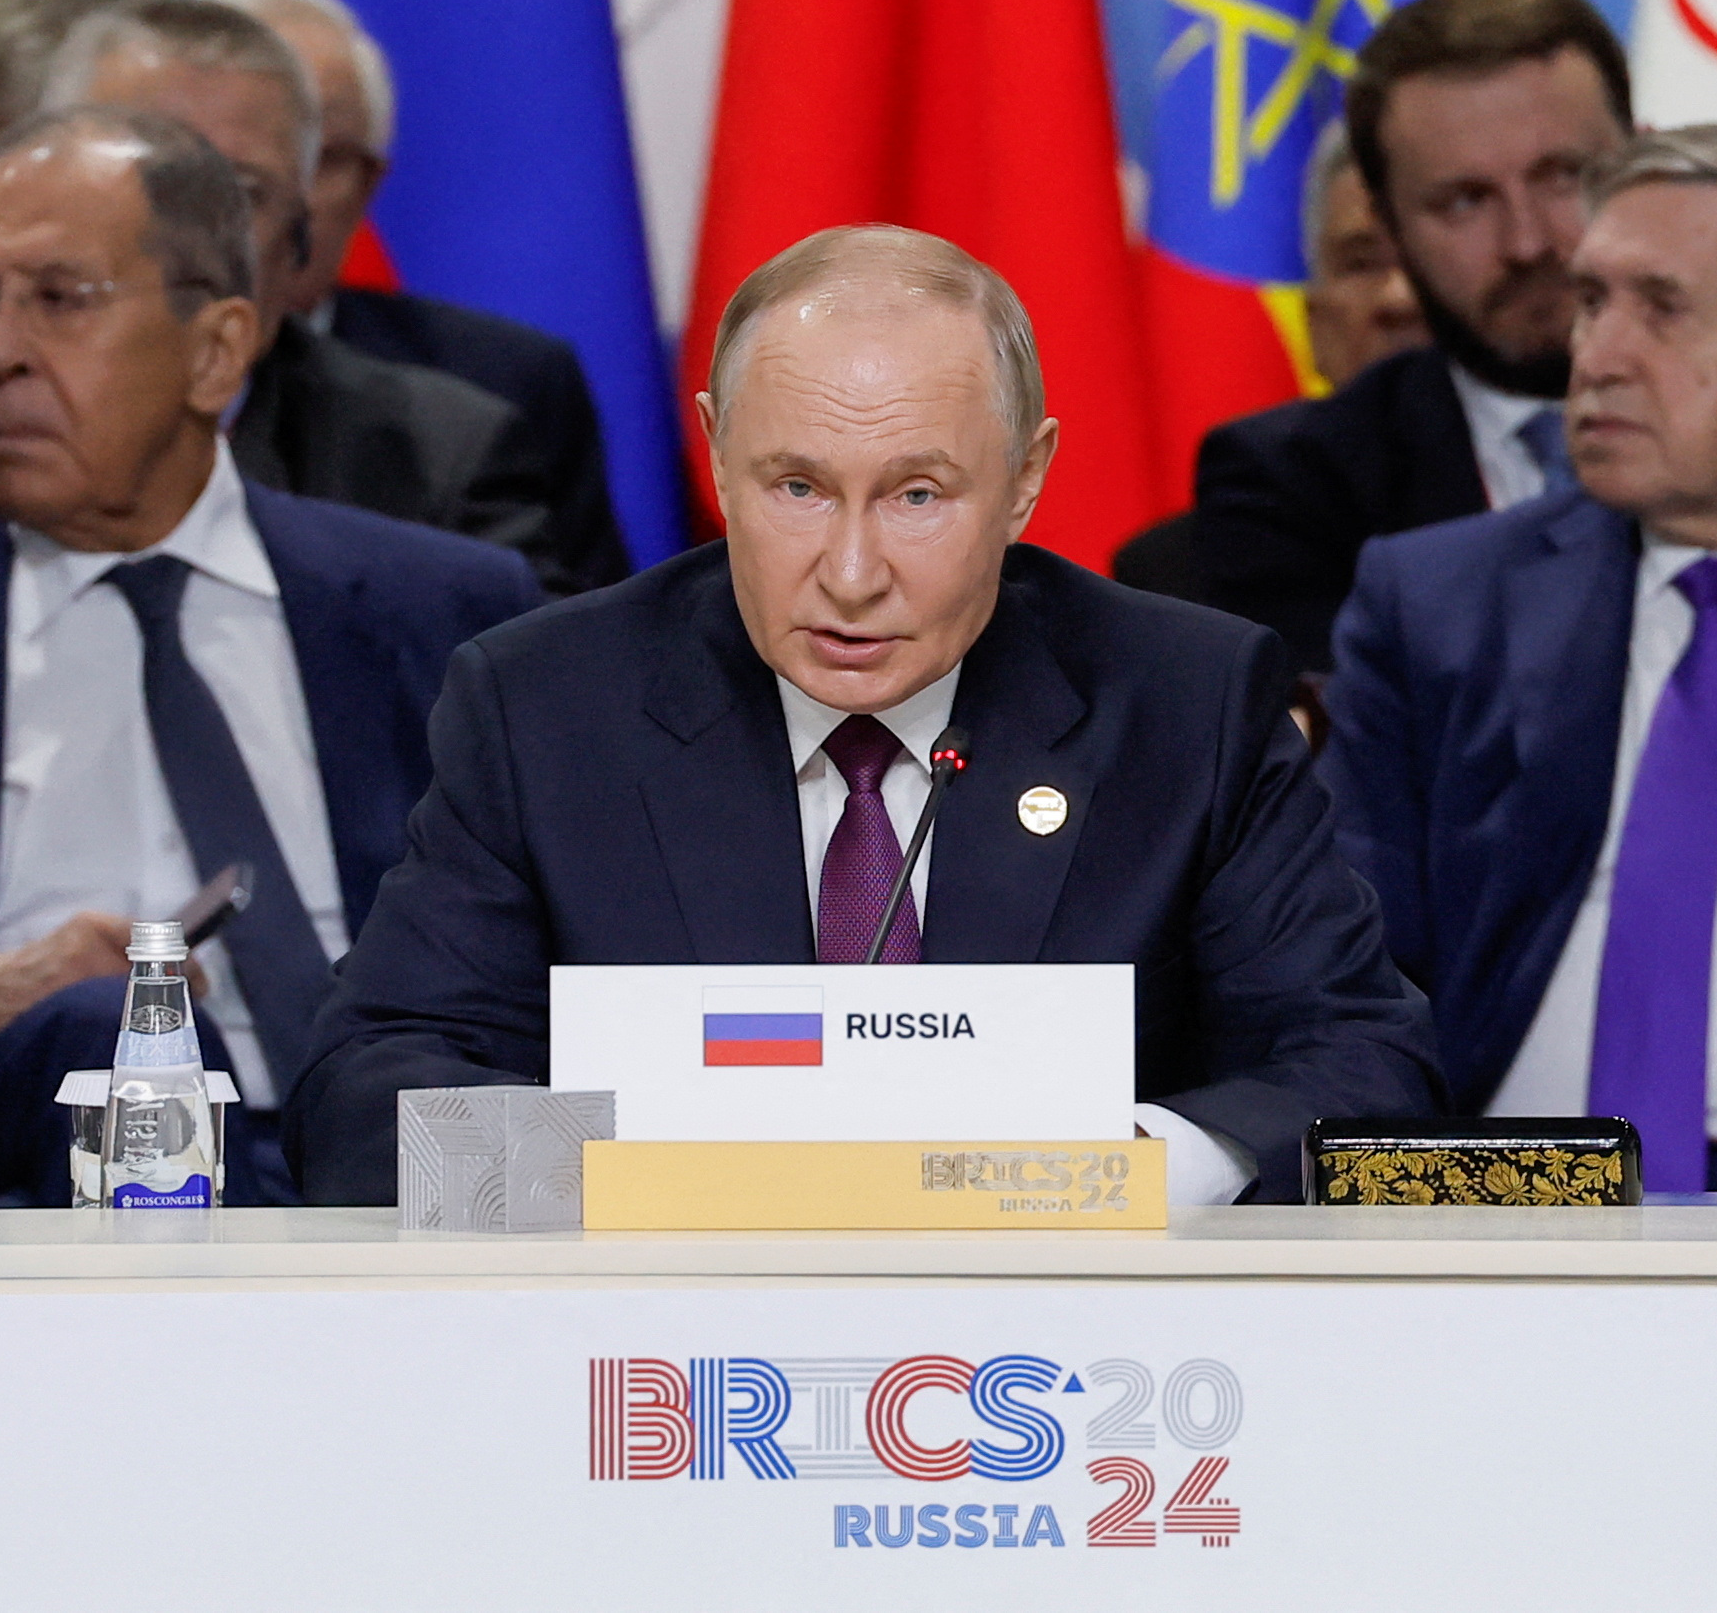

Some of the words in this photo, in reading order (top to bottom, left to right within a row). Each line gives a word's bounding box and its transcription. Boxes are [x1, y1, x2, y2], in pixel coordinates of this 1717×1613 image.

[846, 1013, 976, 1039] RUSSIA
[921, 1150, 1073, 1192] BRICS
[1078, 1151, 1129, 1183] 20
[1078, 1183, 1129, 1213] 24
[588, 1353, 1066, 1482] BRICS
[1084, 1357, 1244, 1450] 20
[833, 1503, 1066, 1548] RUSSIA
[1084, 1455, 1241, 1548] 24
